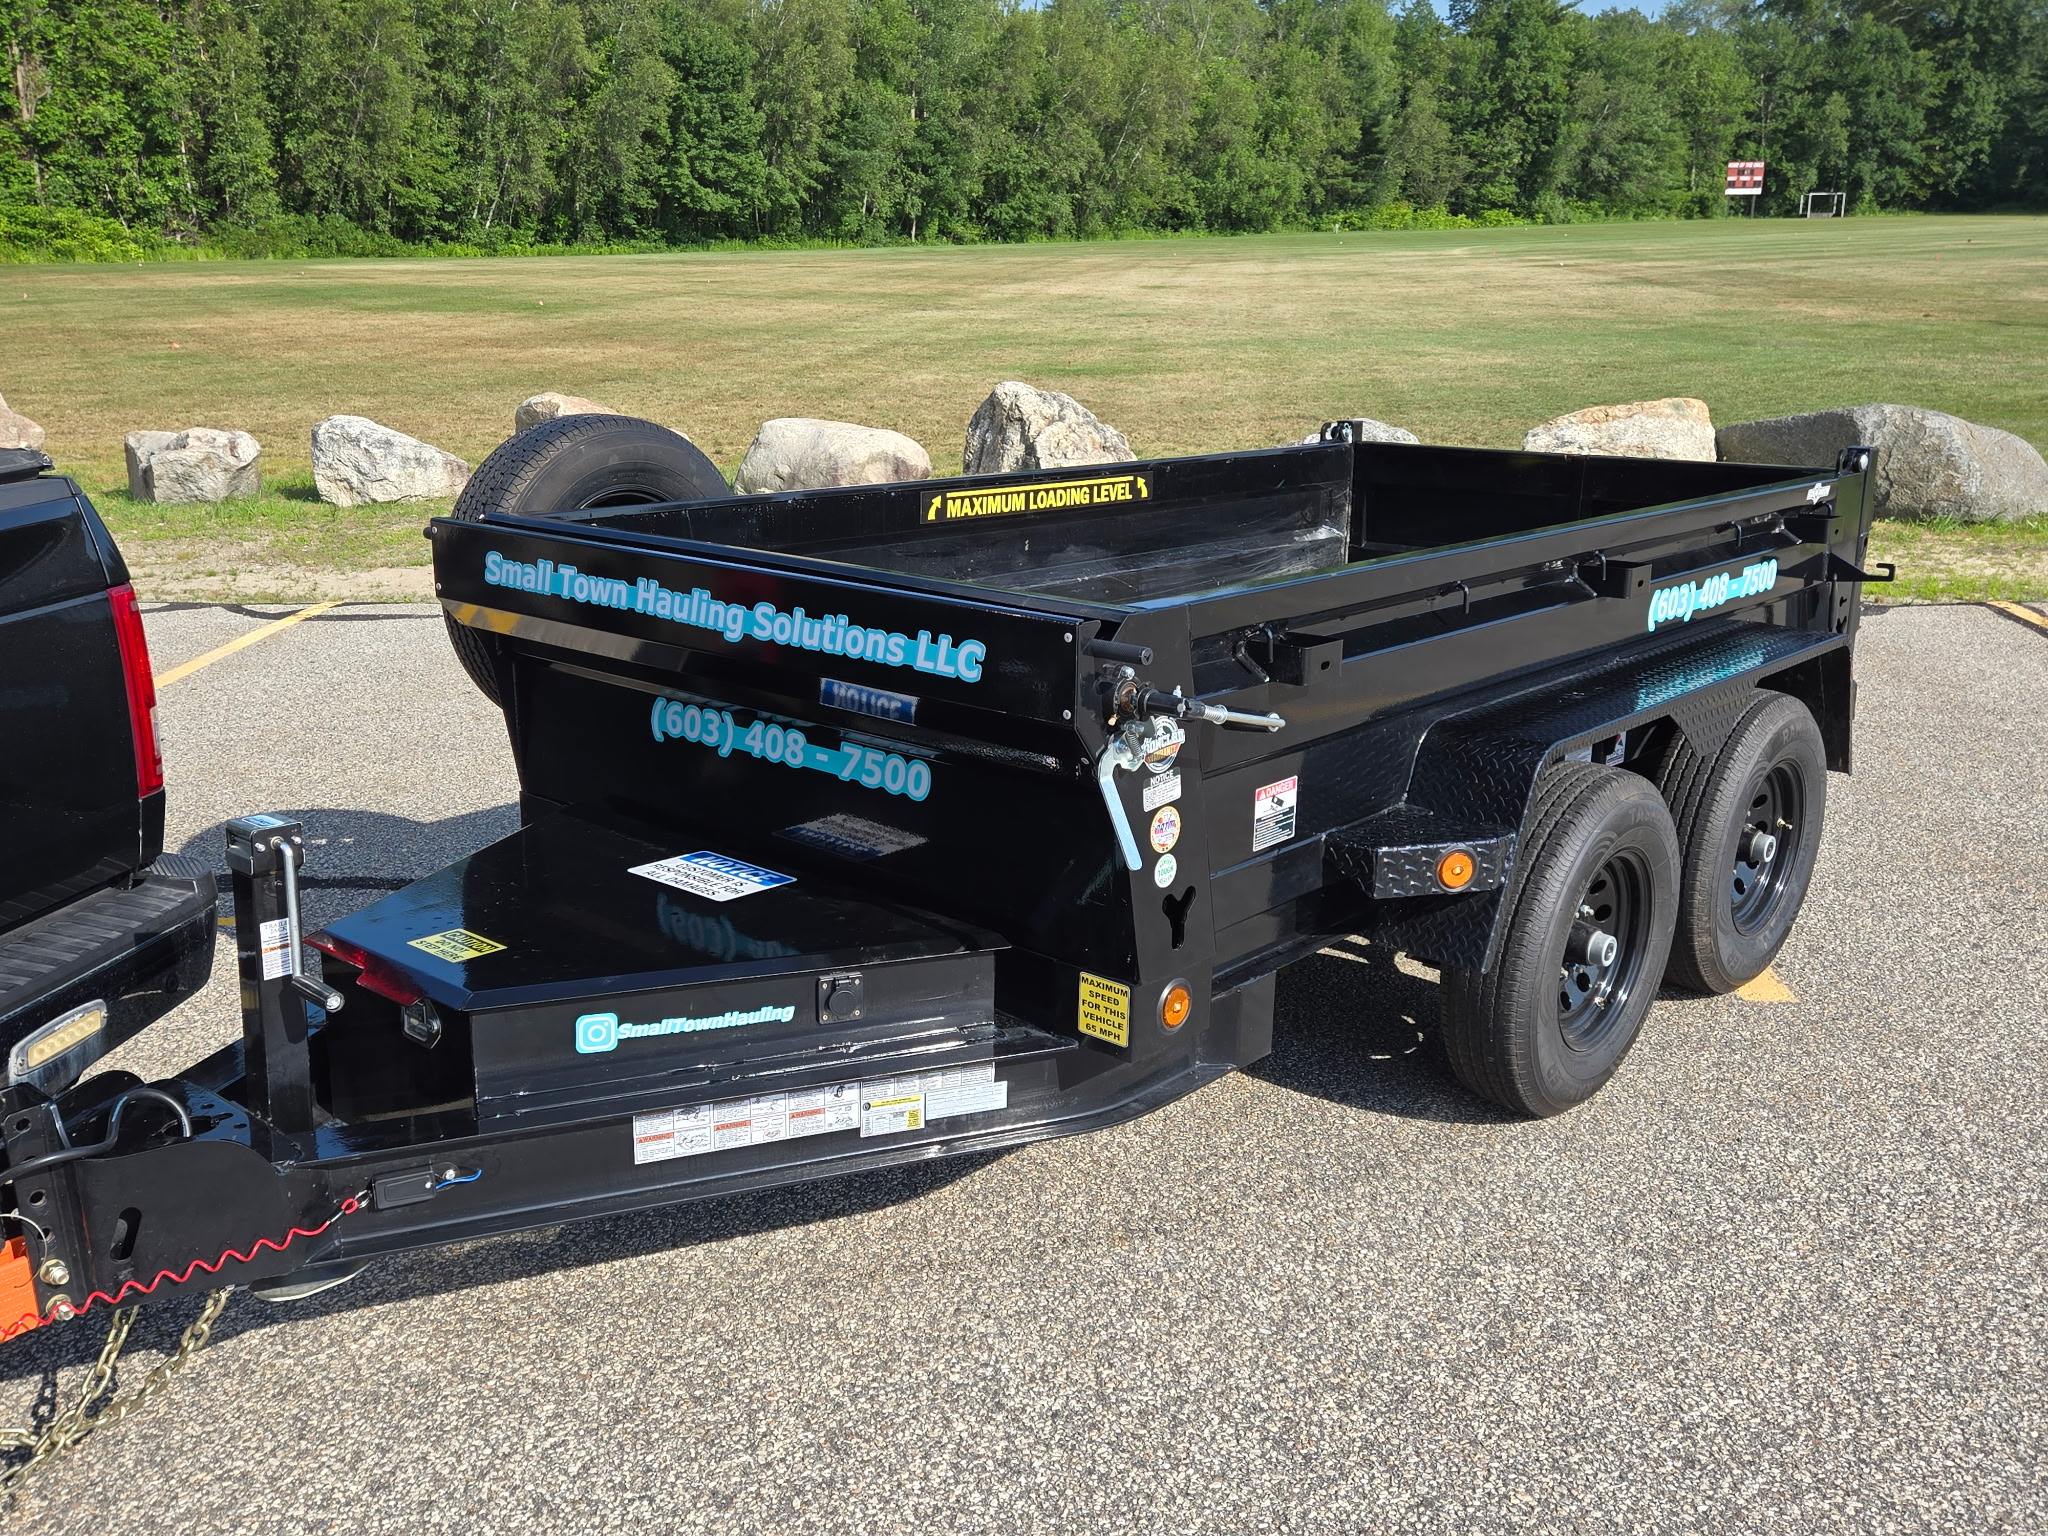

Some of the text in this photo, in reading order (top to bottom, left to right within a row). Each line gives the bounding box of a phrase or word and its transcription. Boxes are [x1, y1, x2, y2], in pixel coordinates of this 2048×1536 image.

[947, 482, 1133, 518] MAXIMUM LOADING LEVEL
[1648, 581, 1696, 632] (603)
[1699, 572, 1730, 610] 408
[1739, 559, 1778, 598] 7500
[485, 552, 986, 682] Small Town Hauling Solutions LLC
[652, 697, 735, 757] (603)
[744, 720, 807, 768] 408
[839, 741, 932, 801] 7500
[1150, 769, 1174, 787] NOTICE
[1267, 780, 1294, 797] DANGER
[653, 863, 745, 896] RESPONSIBLE FOR
[675, 863, 735, 882] CUSTOMER
[690, 856, 780, 883] NOTICE
[642, 871, 720, 897] ALL DAMAGES
[416, 940, 465, 961] STEP HERE
[449, 944, 470, 953] NOT
[1081, 976, 1128, 998] MAXIMUM
[1088, 990, 1120, 1006] SPEED
[1081, 999, 1126, 1020] FOR THIS
[616, 1005, 796, 1040] SmallTownHauling
[1083, 1010, 1124, 1031] VEHICLE
[1085, 1022, 1120, 1041] 65 MPH
